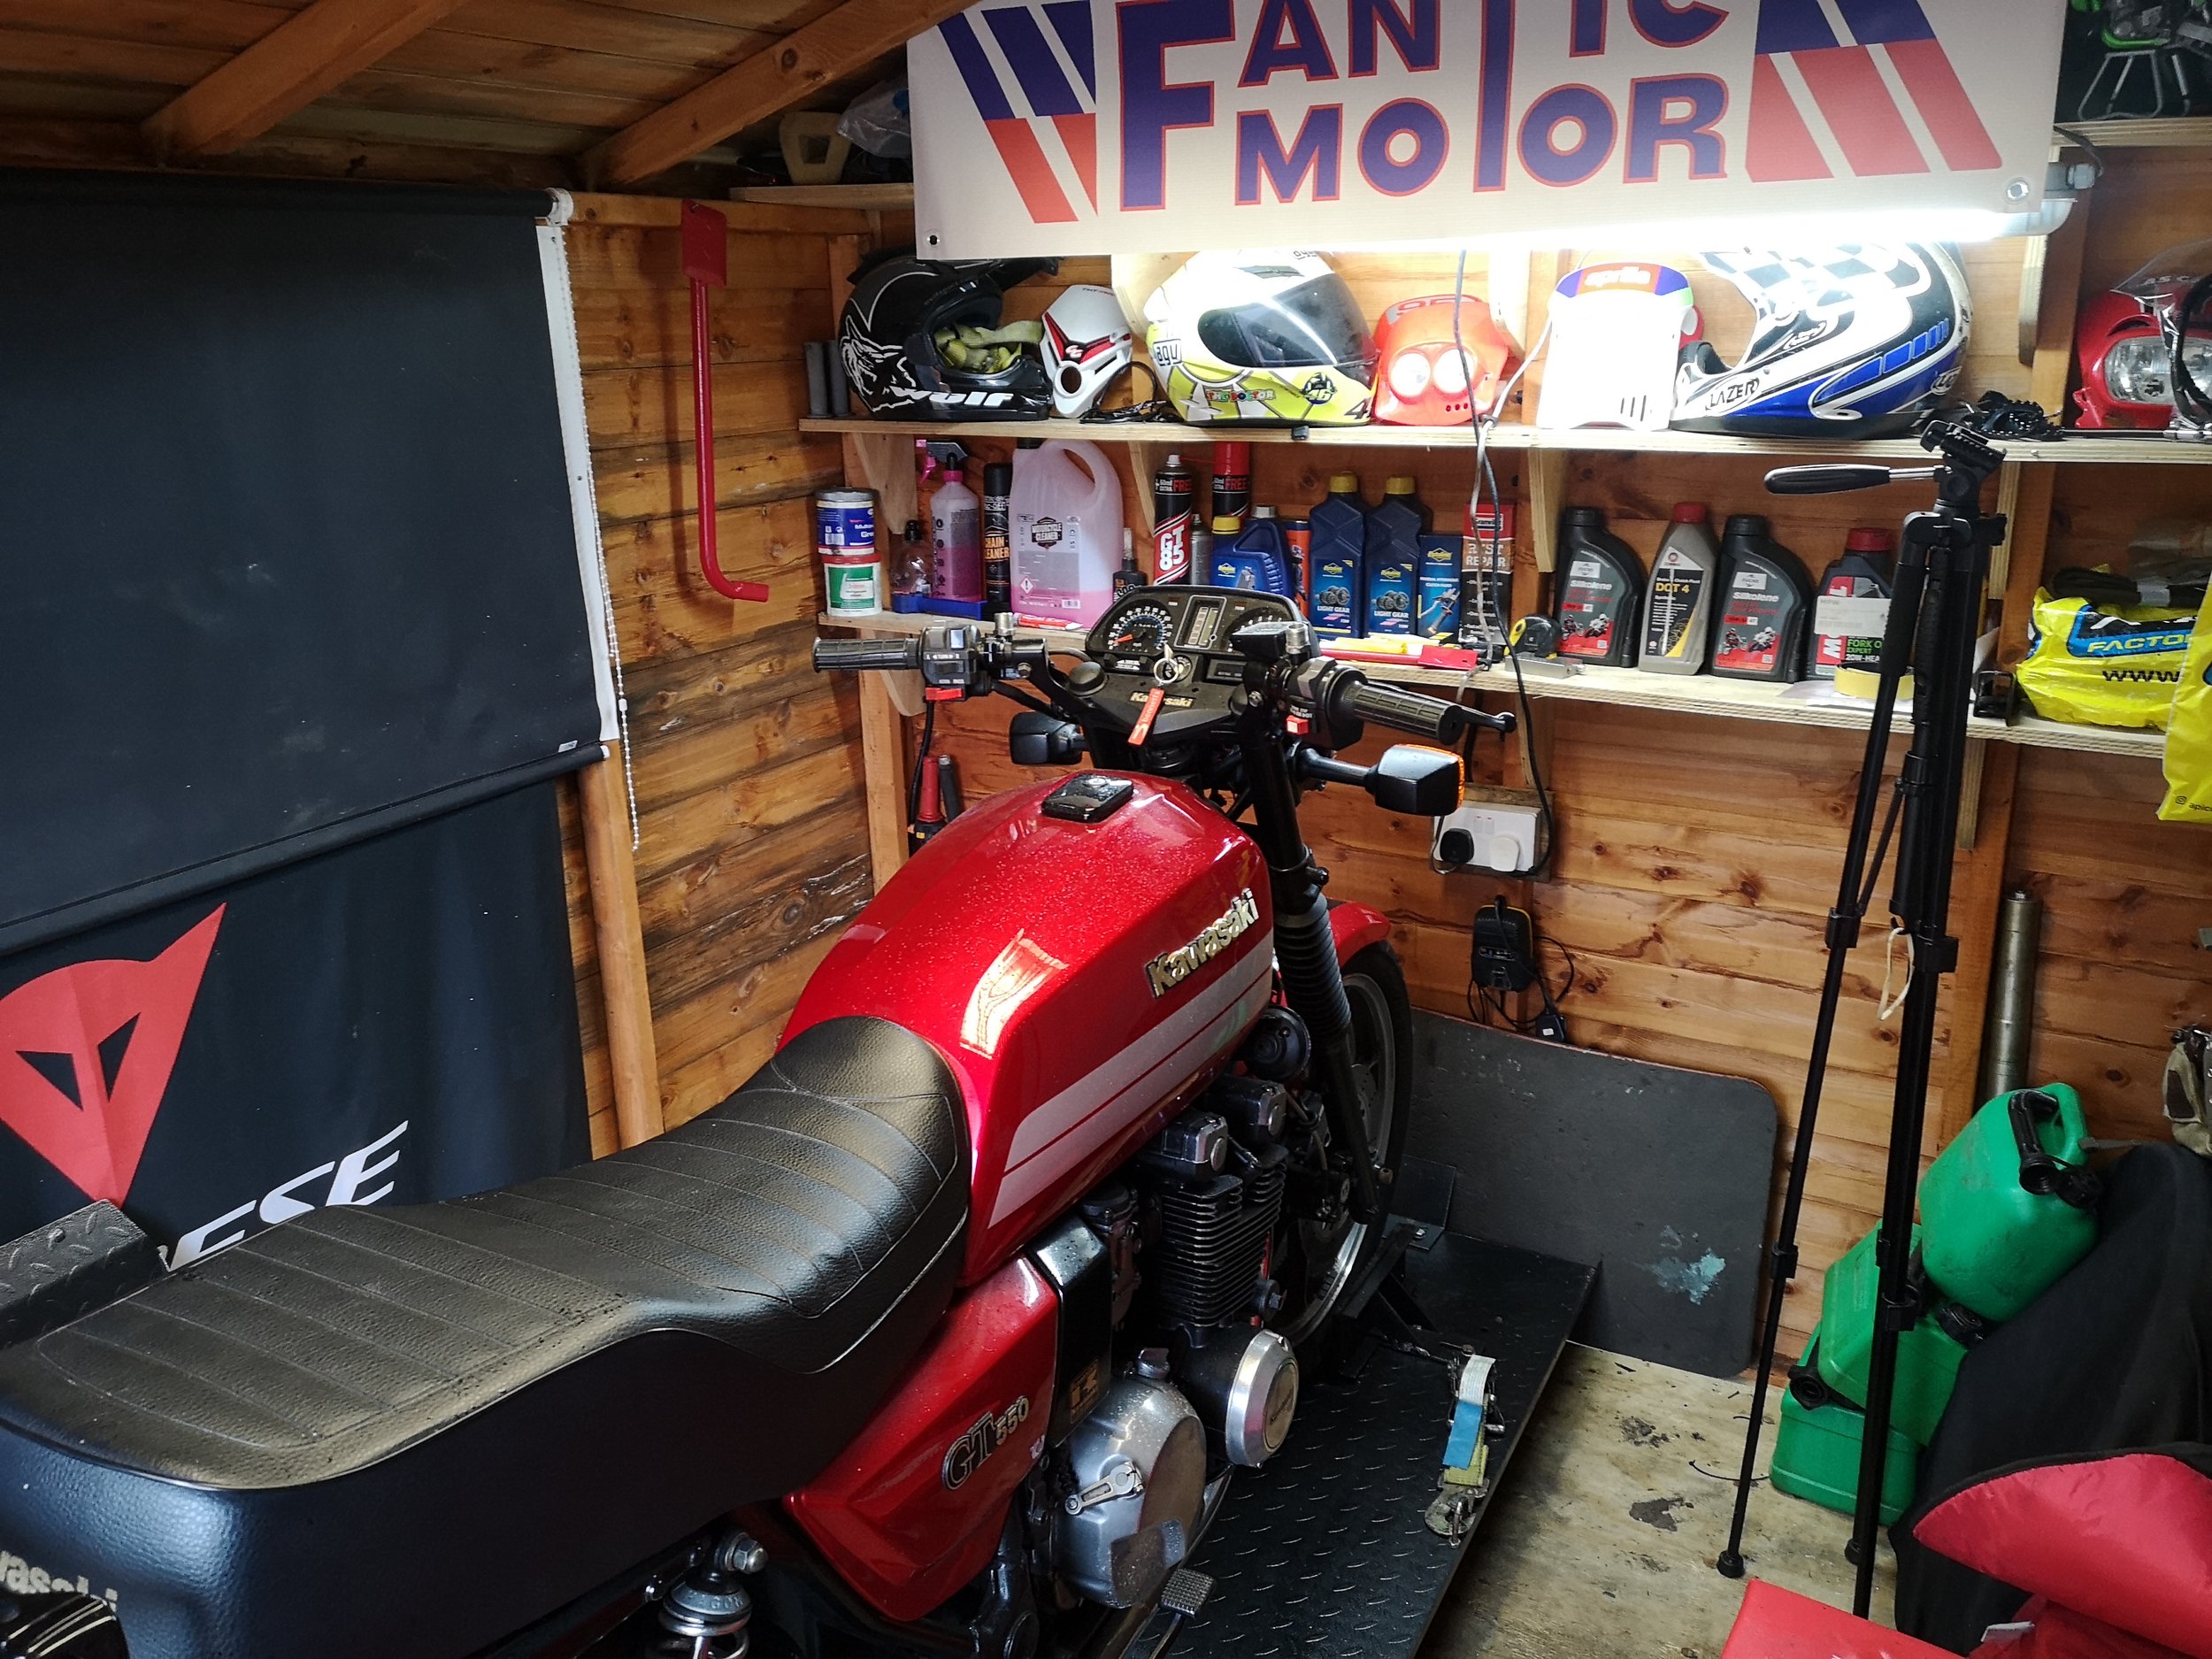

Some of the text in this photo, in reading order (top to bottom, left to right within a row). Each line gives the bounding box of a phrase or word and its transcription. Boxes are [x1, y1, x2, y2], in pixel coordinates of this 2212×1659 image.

[1207, 390, 1228, 403] THE
[1231, 388, 1275, 403] DOCTOR
[1707, 379, 1759, 410] LAZER
[1344, 397, 1371, 419] 4
[1160, 525, 1185, 549] GT
[1468, 543, 1504, 555] RST
[1159, 545, 1185, 571] 85
[1465, 556, 1506, 567] REPAR
[1570, 580, 1612, 590] Silkolene
[1655, 582, 1690, 594] DOT 4
[1732, 591, 1779, 602] Silkolene
[1847, 639, 1872, 648] FORK
[2086, 633, 2192, 654] FACTO
[1130, 692, 1194, 708] Kasaki
[1145, 887, 1260, 999] Kawasaki
